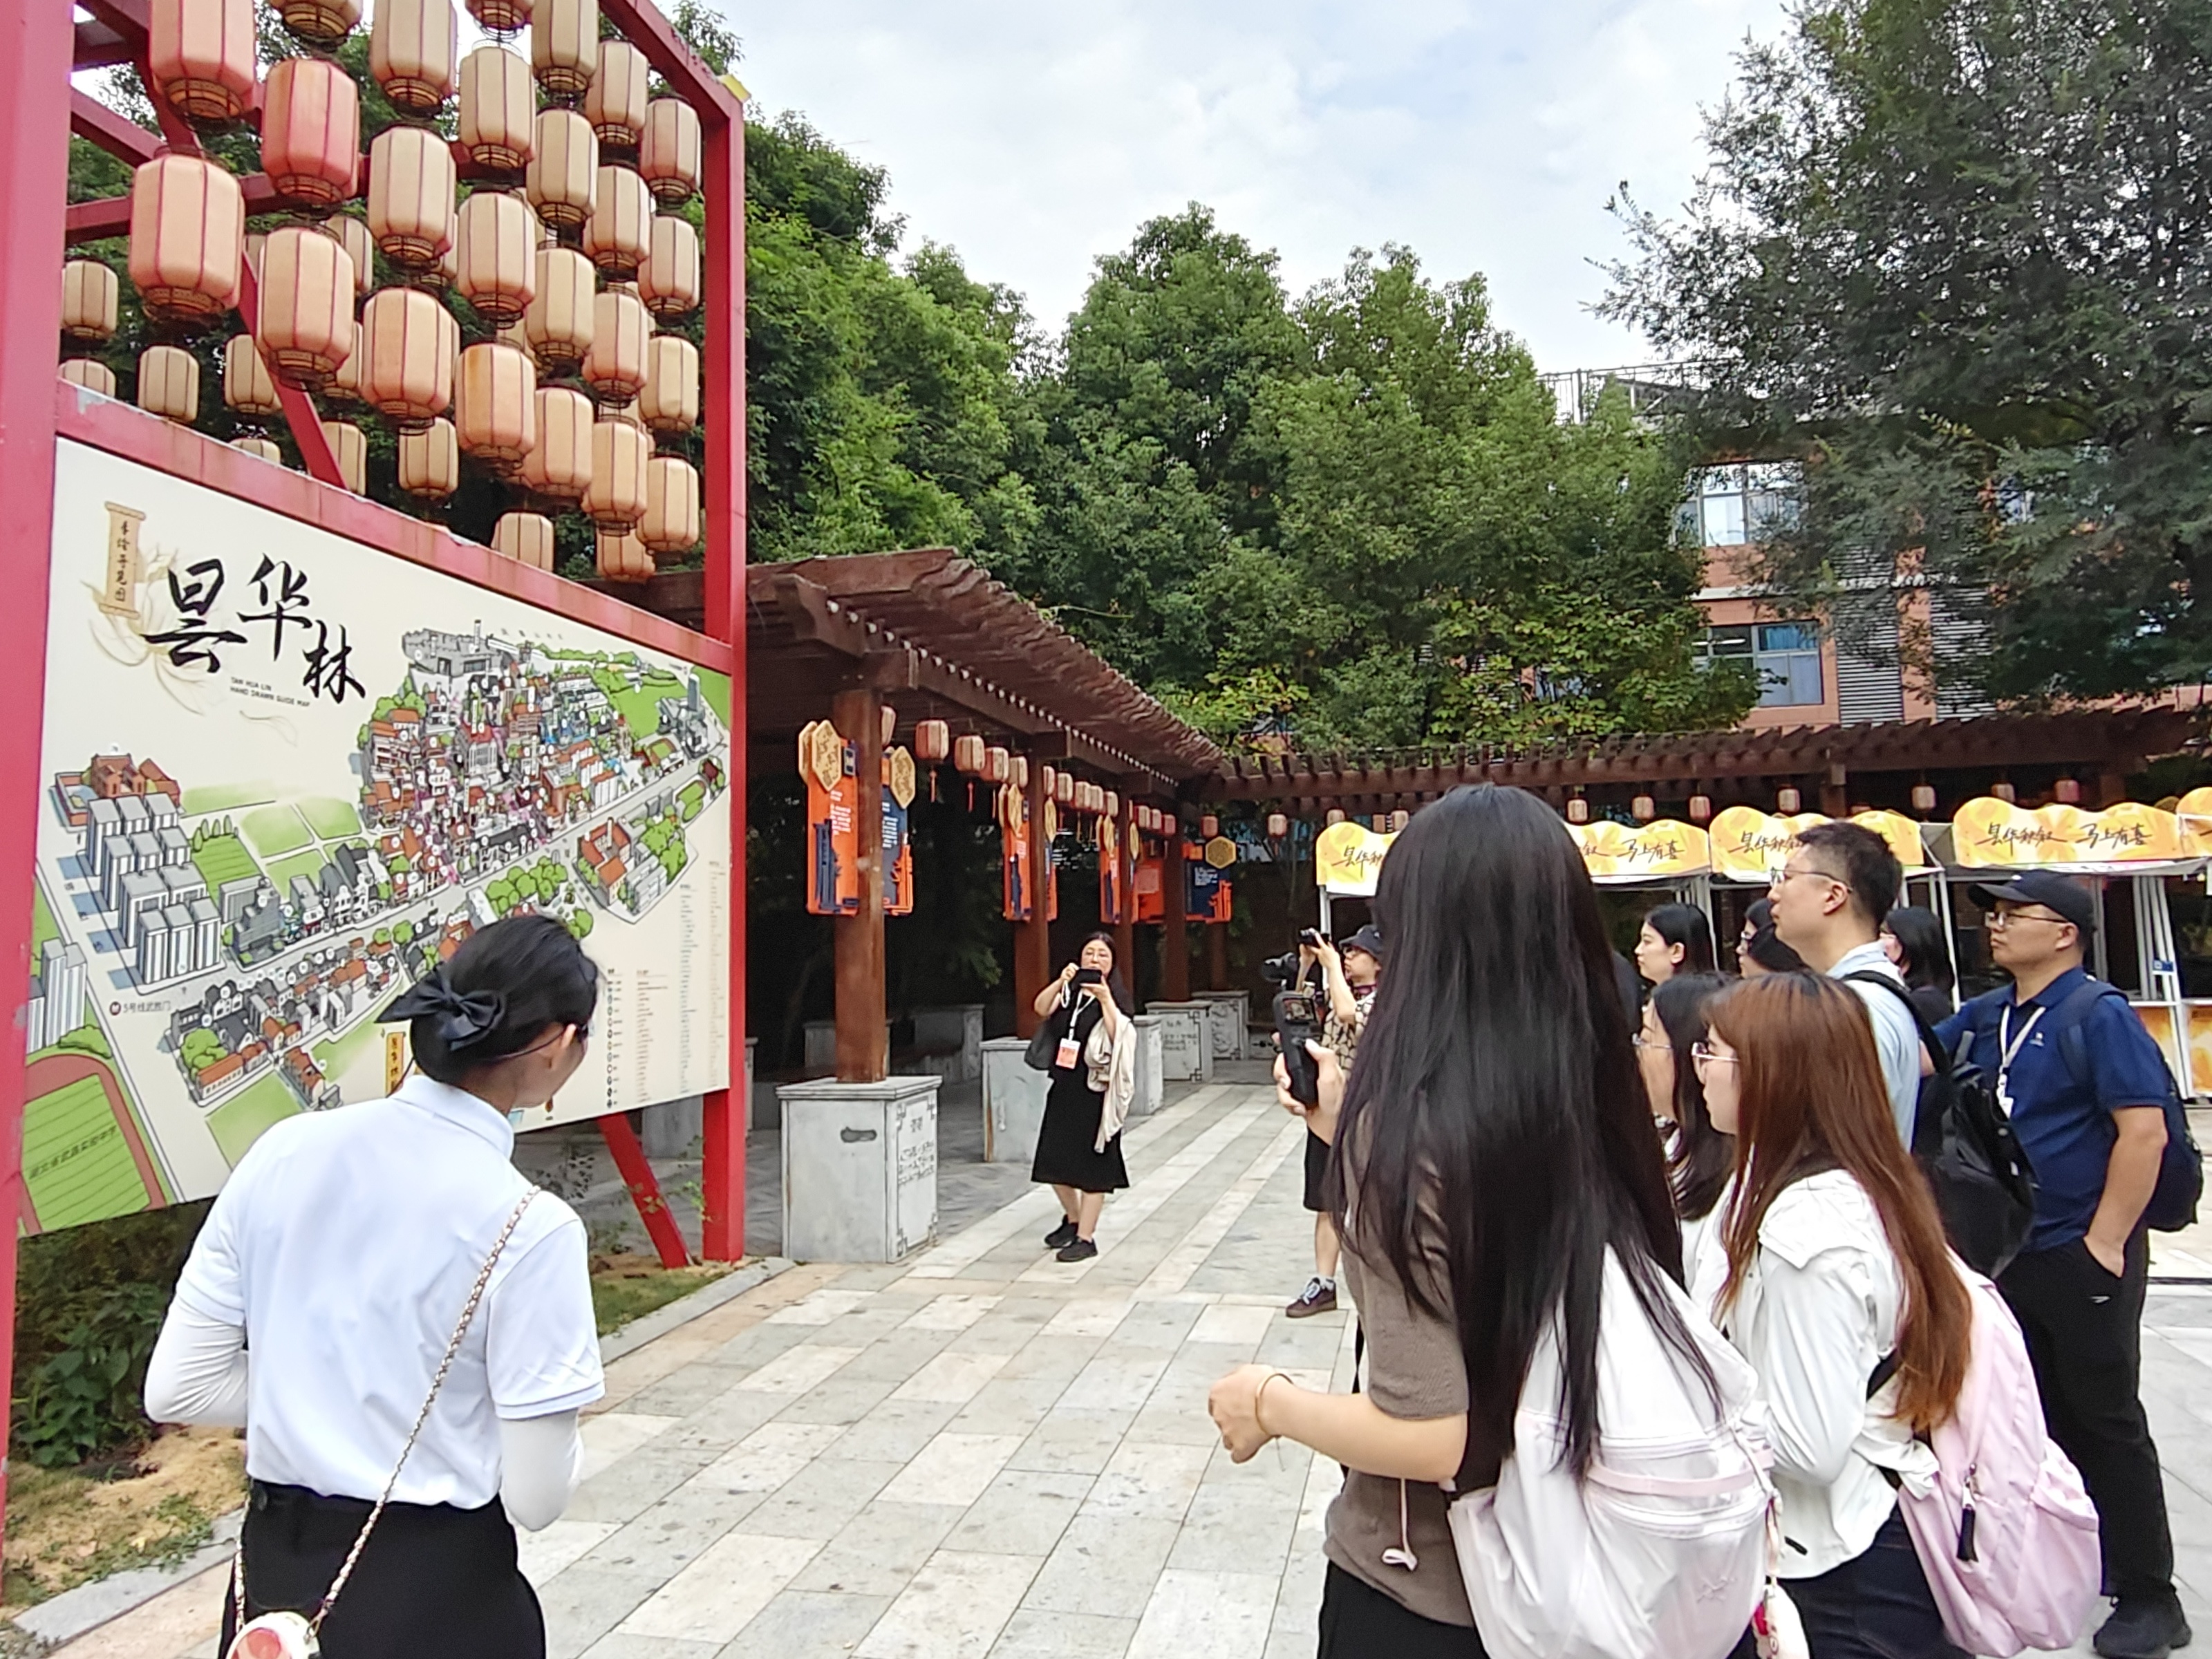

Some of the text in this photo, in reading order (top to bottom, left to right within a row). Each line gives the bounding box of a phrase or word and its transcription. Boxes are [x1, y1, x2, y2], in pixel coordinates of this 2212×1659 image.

[140, 553, 365, 704] 昙华林
[230, 686, 248, 695] HAND
[251, 690, 274, 700] DRAWN
[276, 695, 294, 705] GUIDE
[2075, 823, 2153, 850] 马上有喜
[1616, 838, 1685, 863] 马上有喜
